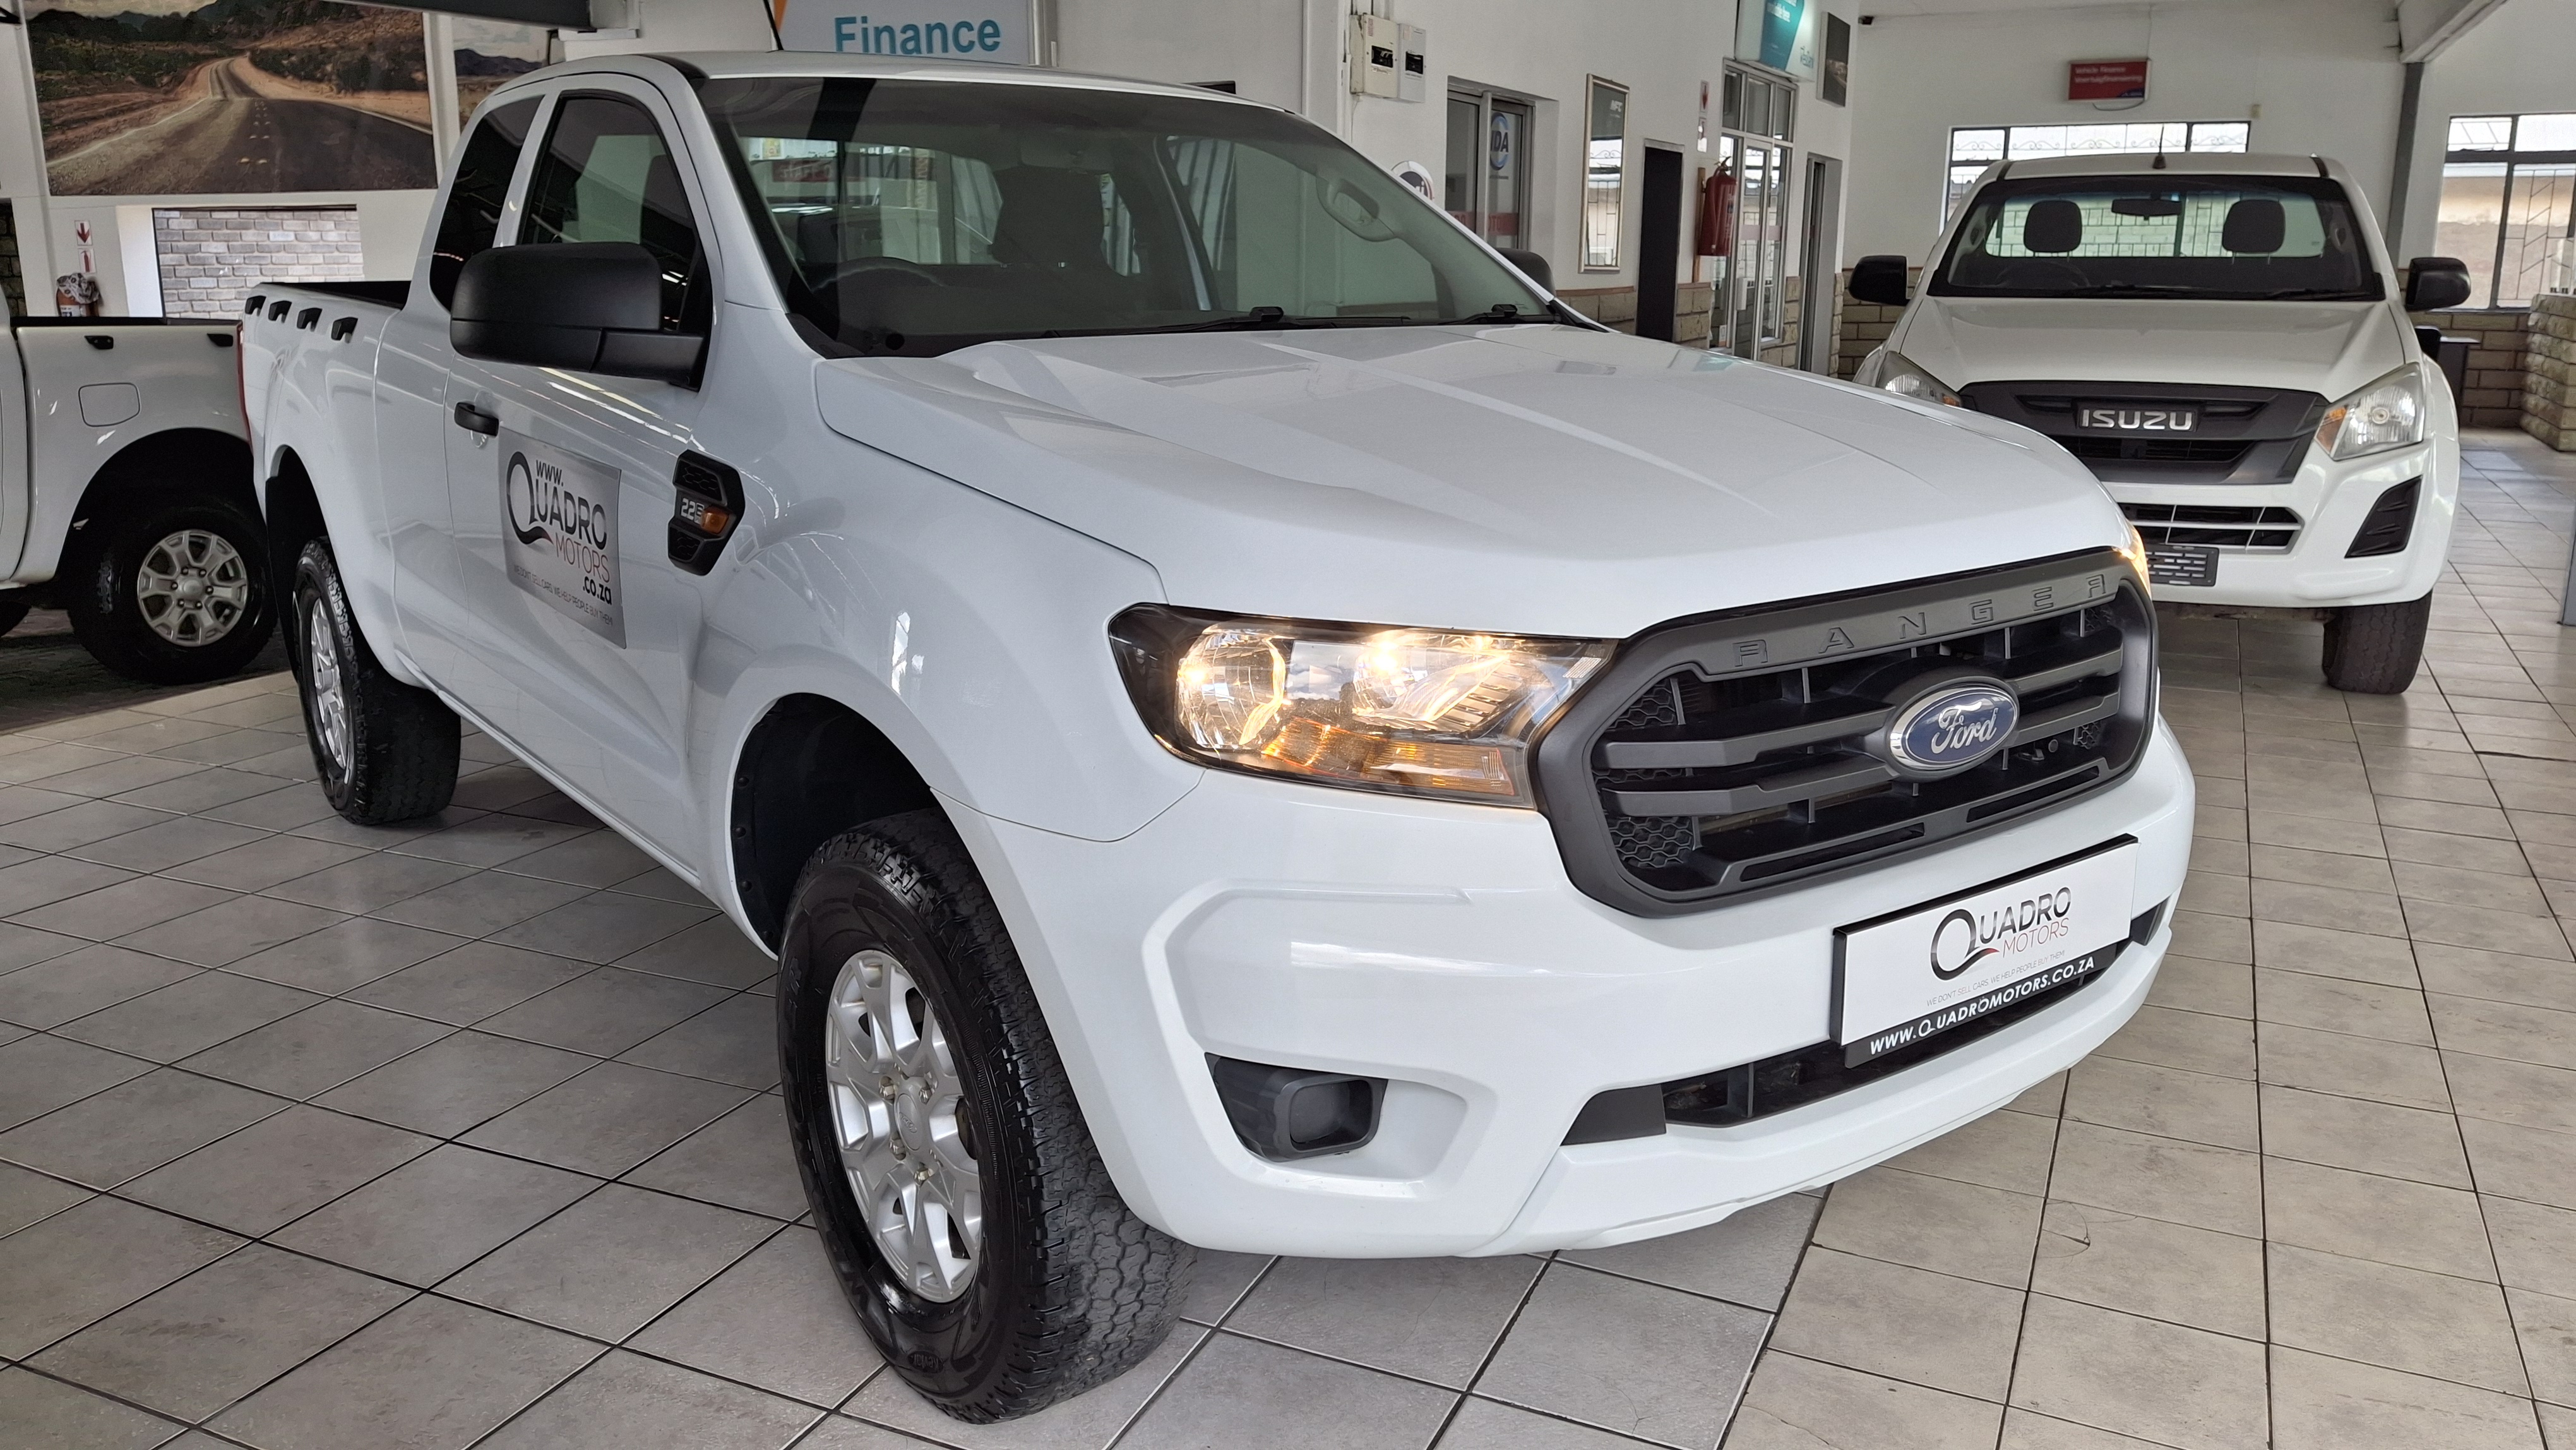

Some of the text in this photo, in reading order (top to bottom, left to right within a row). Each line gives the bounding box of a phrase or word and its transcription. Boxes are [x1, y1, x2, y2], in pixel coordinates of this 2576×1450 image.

[835, 16, 1001, 55] Finance
[2082, 409, 2193, 431] ISUZU
[506, 451, 607, 551] QUADRO
[556, 532, 611, 584] MOTORS
[583, 576, 612, 605] .co.za
[1734, 573, 2106, 668] RANGER
[1931, 701, 1998, 755] Ford
[1930, 887, 2072, 981] QUADRO
[2003, 918, 2070, 958] MOTORS
[1957, 985, 1972, 996] SELL
[2001, 969, 2016, 980] HELP
[2016, 960, 2037, 974] PEOPLE
[2037, 956, 2049, 967] BUY
[1870, 956, 2095, 1055] WWW.QUADROMOTORS.CO.ZA
